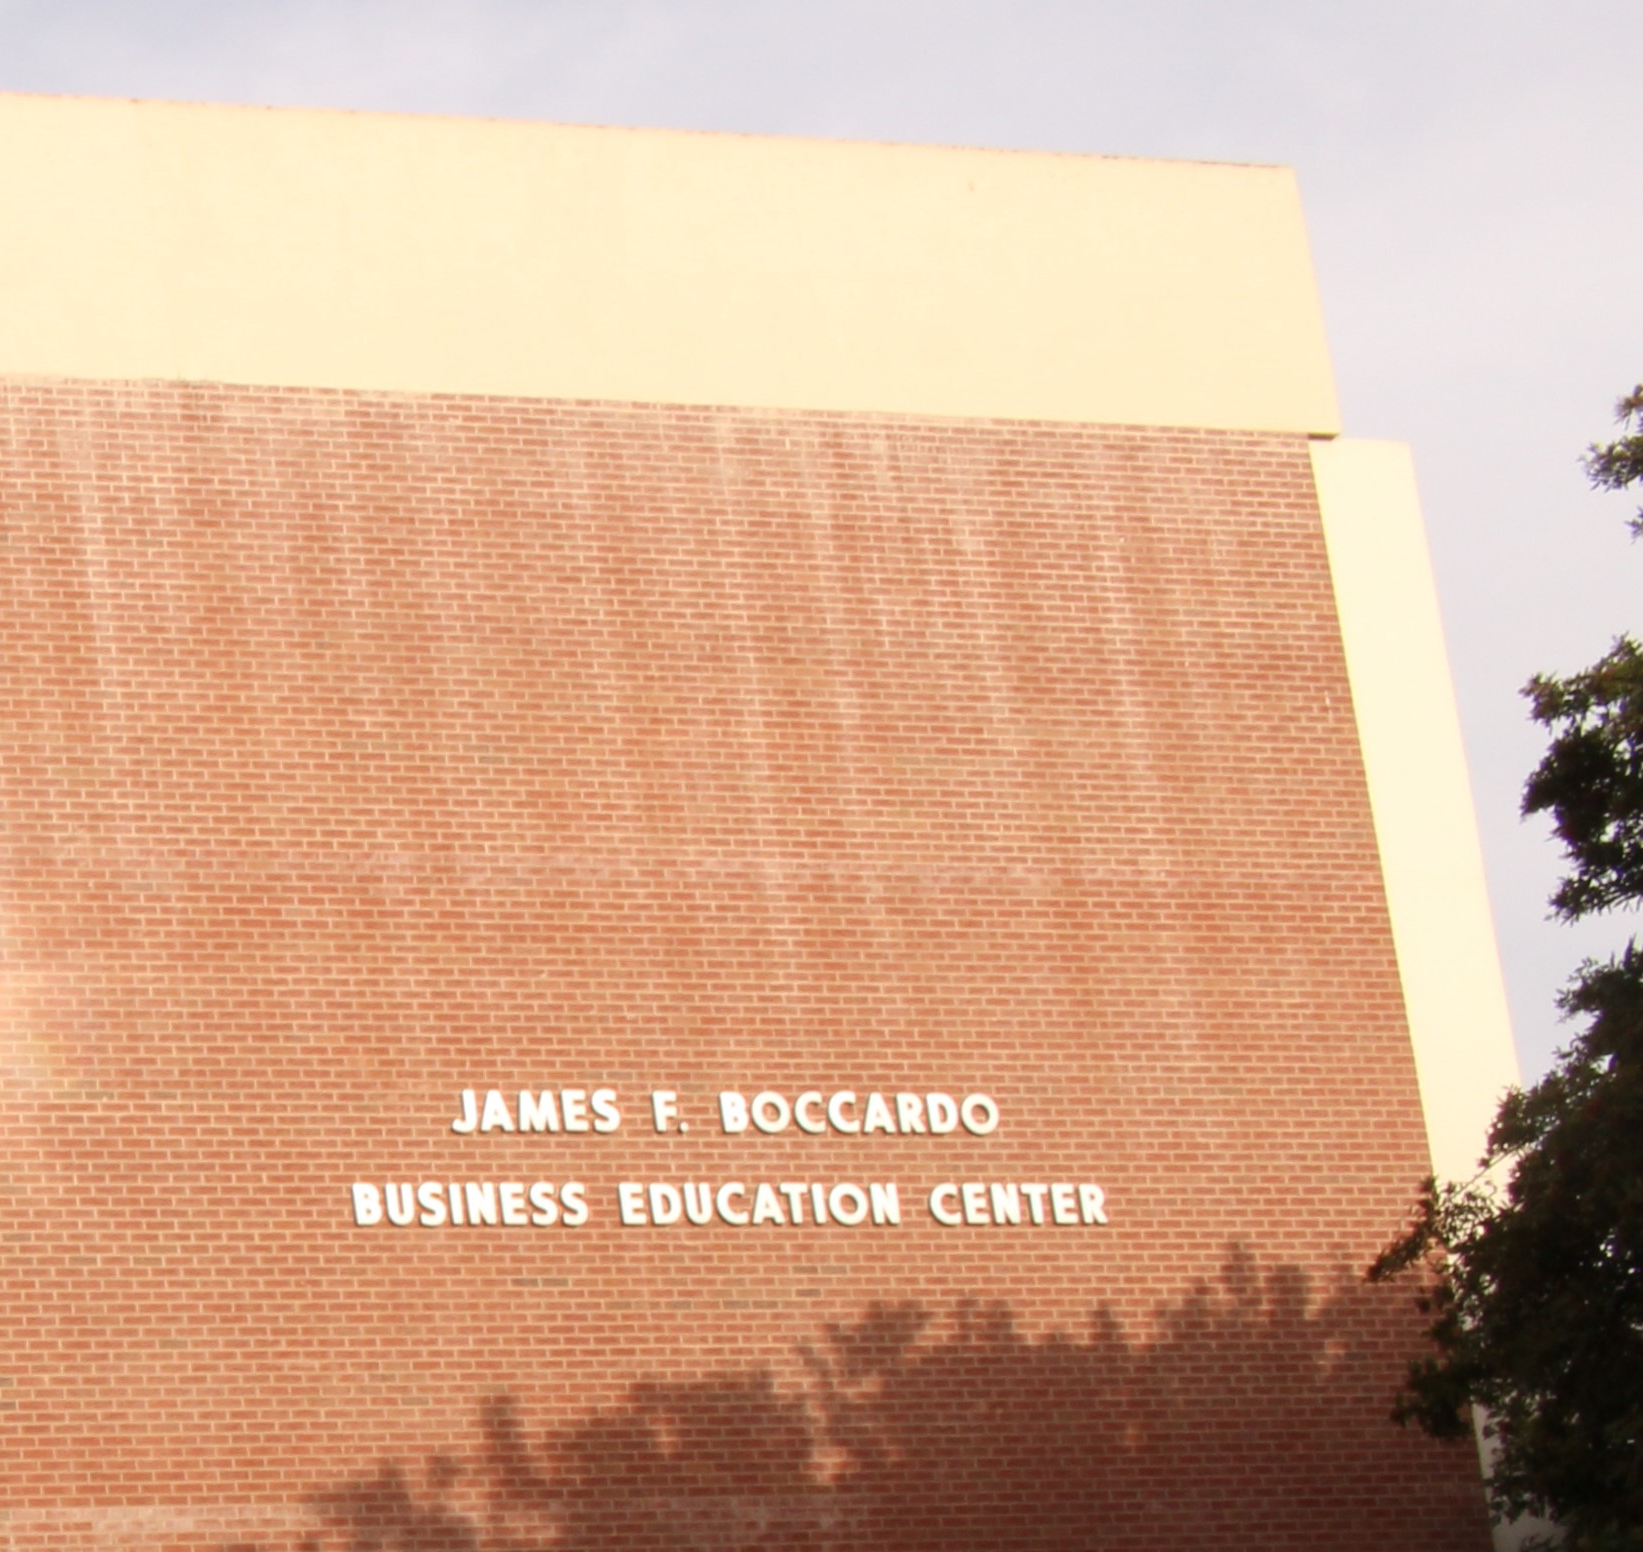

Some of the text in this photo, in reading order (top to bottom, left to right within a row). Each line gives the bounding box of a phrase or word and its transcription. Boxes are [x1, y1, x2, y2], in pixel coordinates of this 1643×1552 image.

[451, 1087, 1000, 1136] JAMES F. BOCCARDO
[351, 1180, 1110, 1227] BUSINESS EDUCATION CENTER
